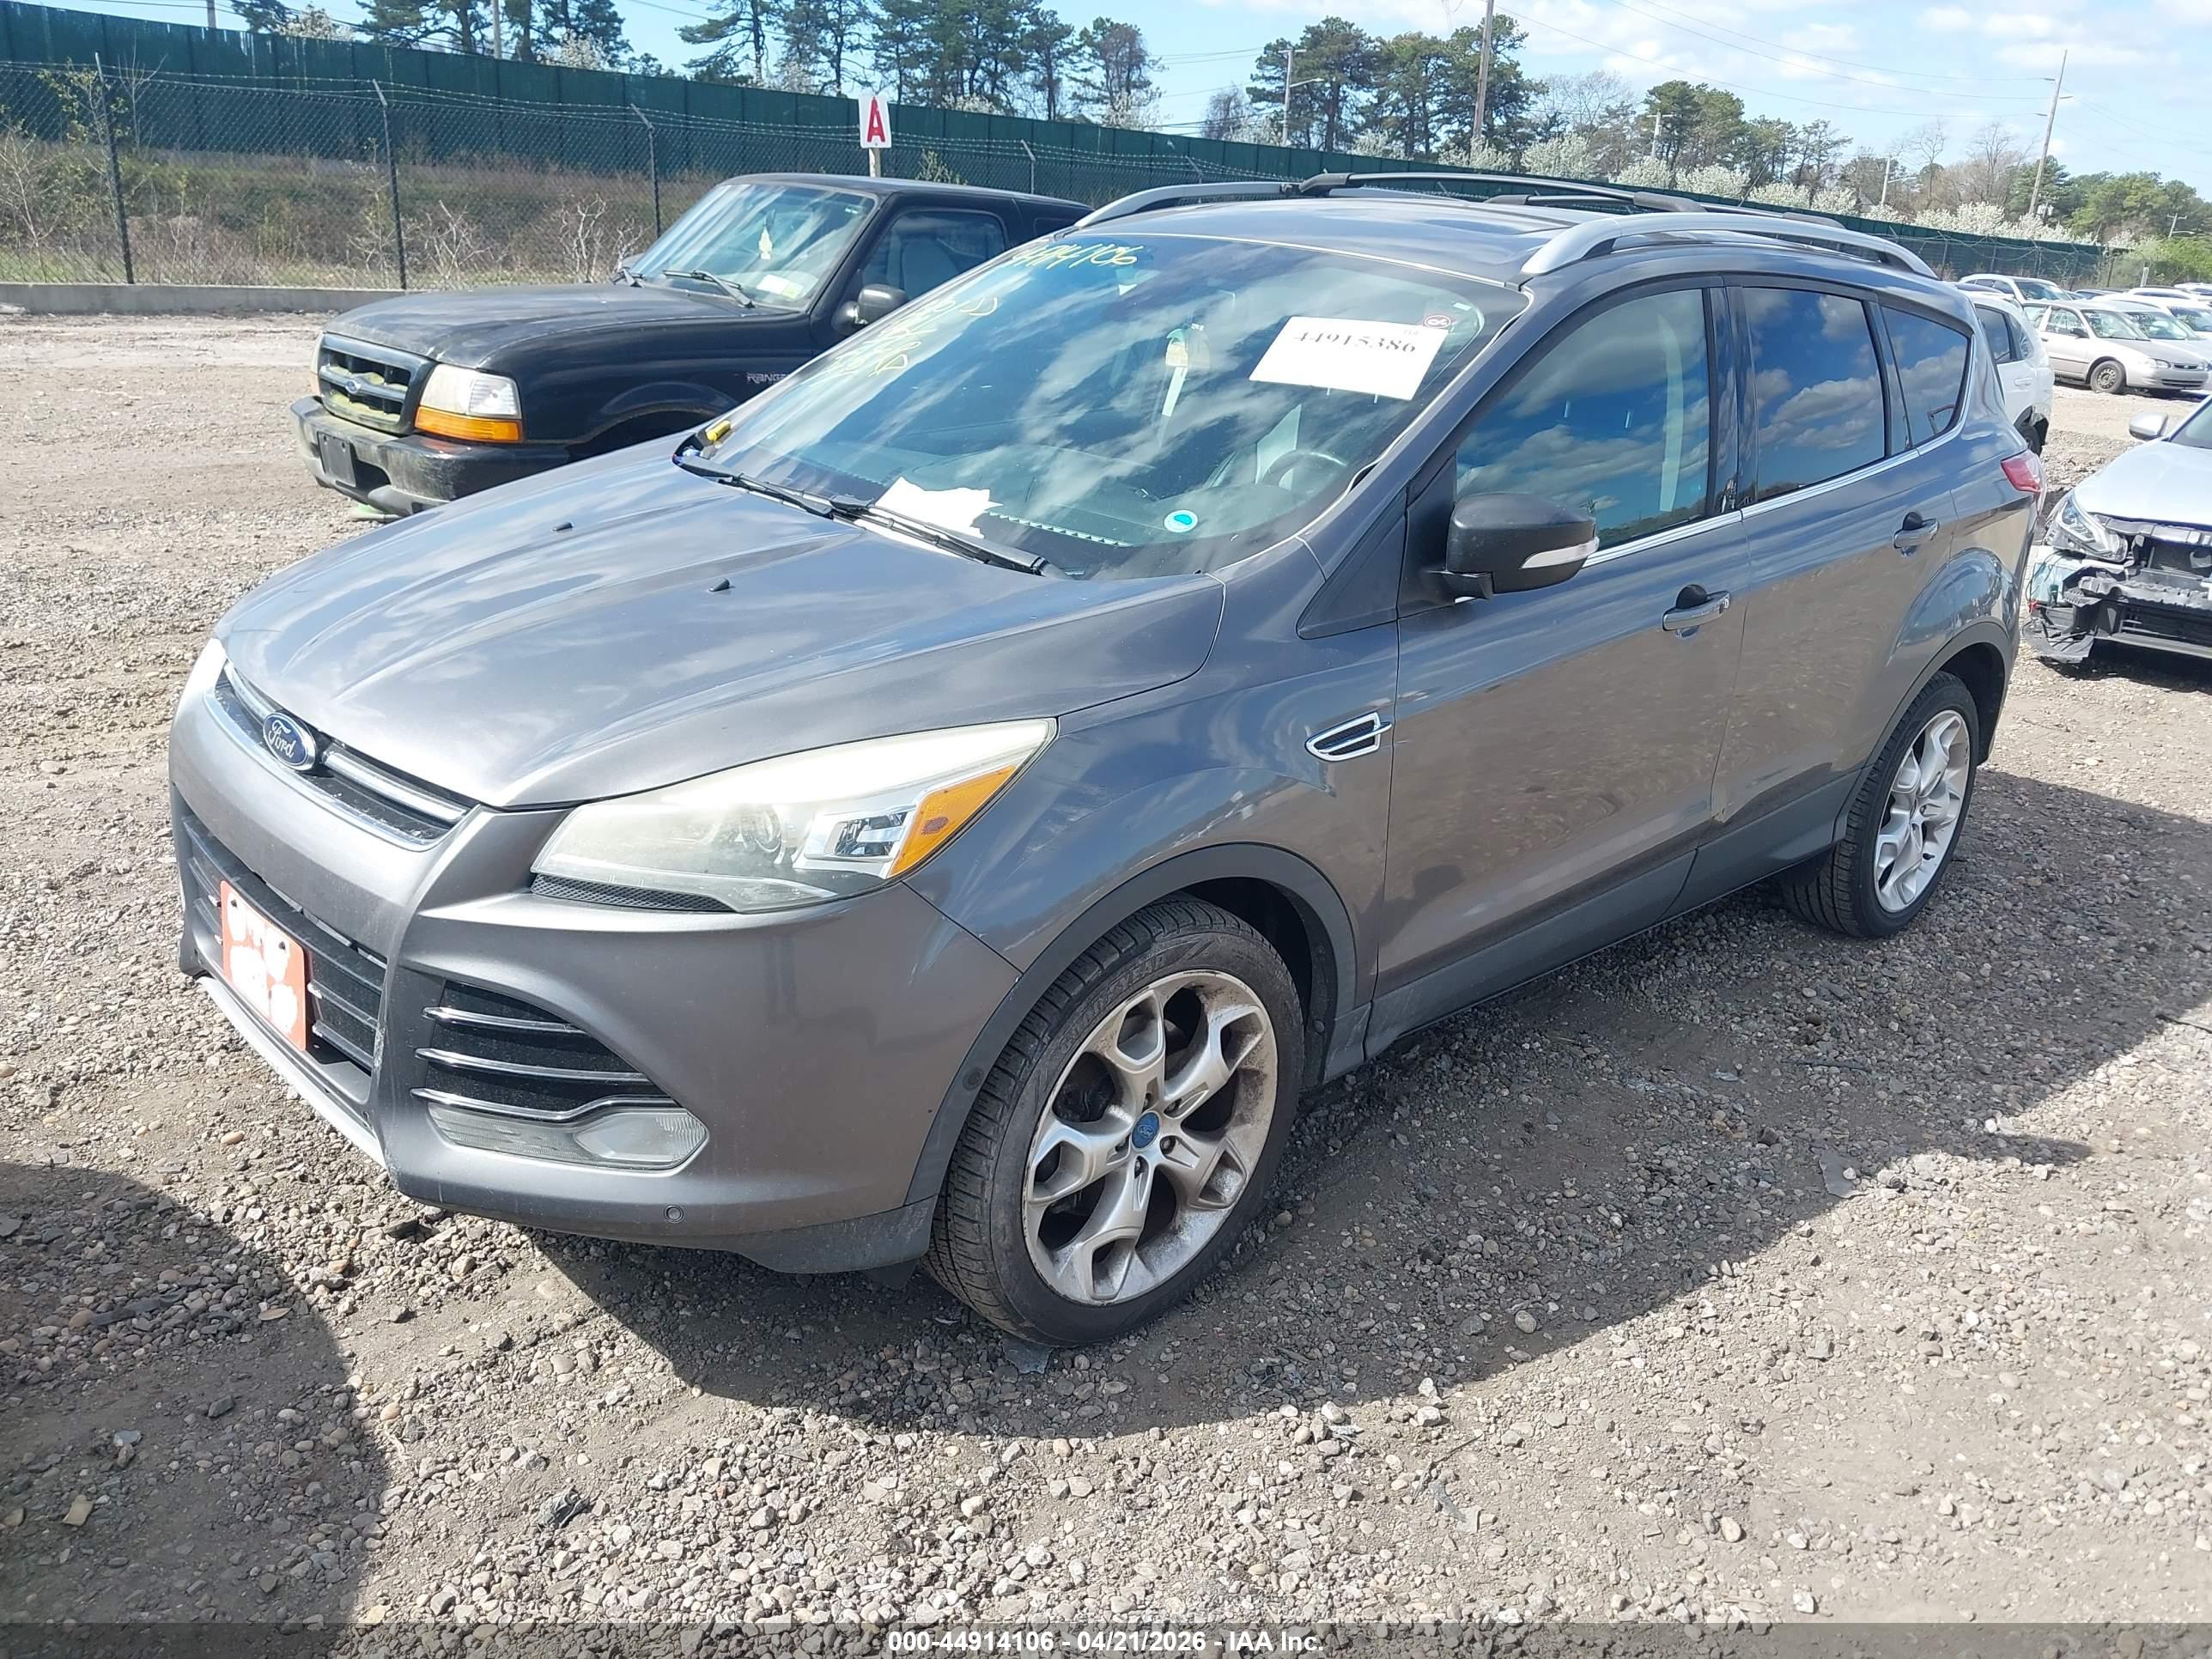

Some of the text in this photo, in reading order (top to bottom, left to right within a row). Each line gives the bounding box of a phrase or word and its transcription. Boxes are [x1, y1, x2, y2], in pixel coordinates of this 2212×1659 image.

[867, 96, 885, 143] A
[746, 373, 791, 384] RANGE
[268, 720, 296, 758] Ford
